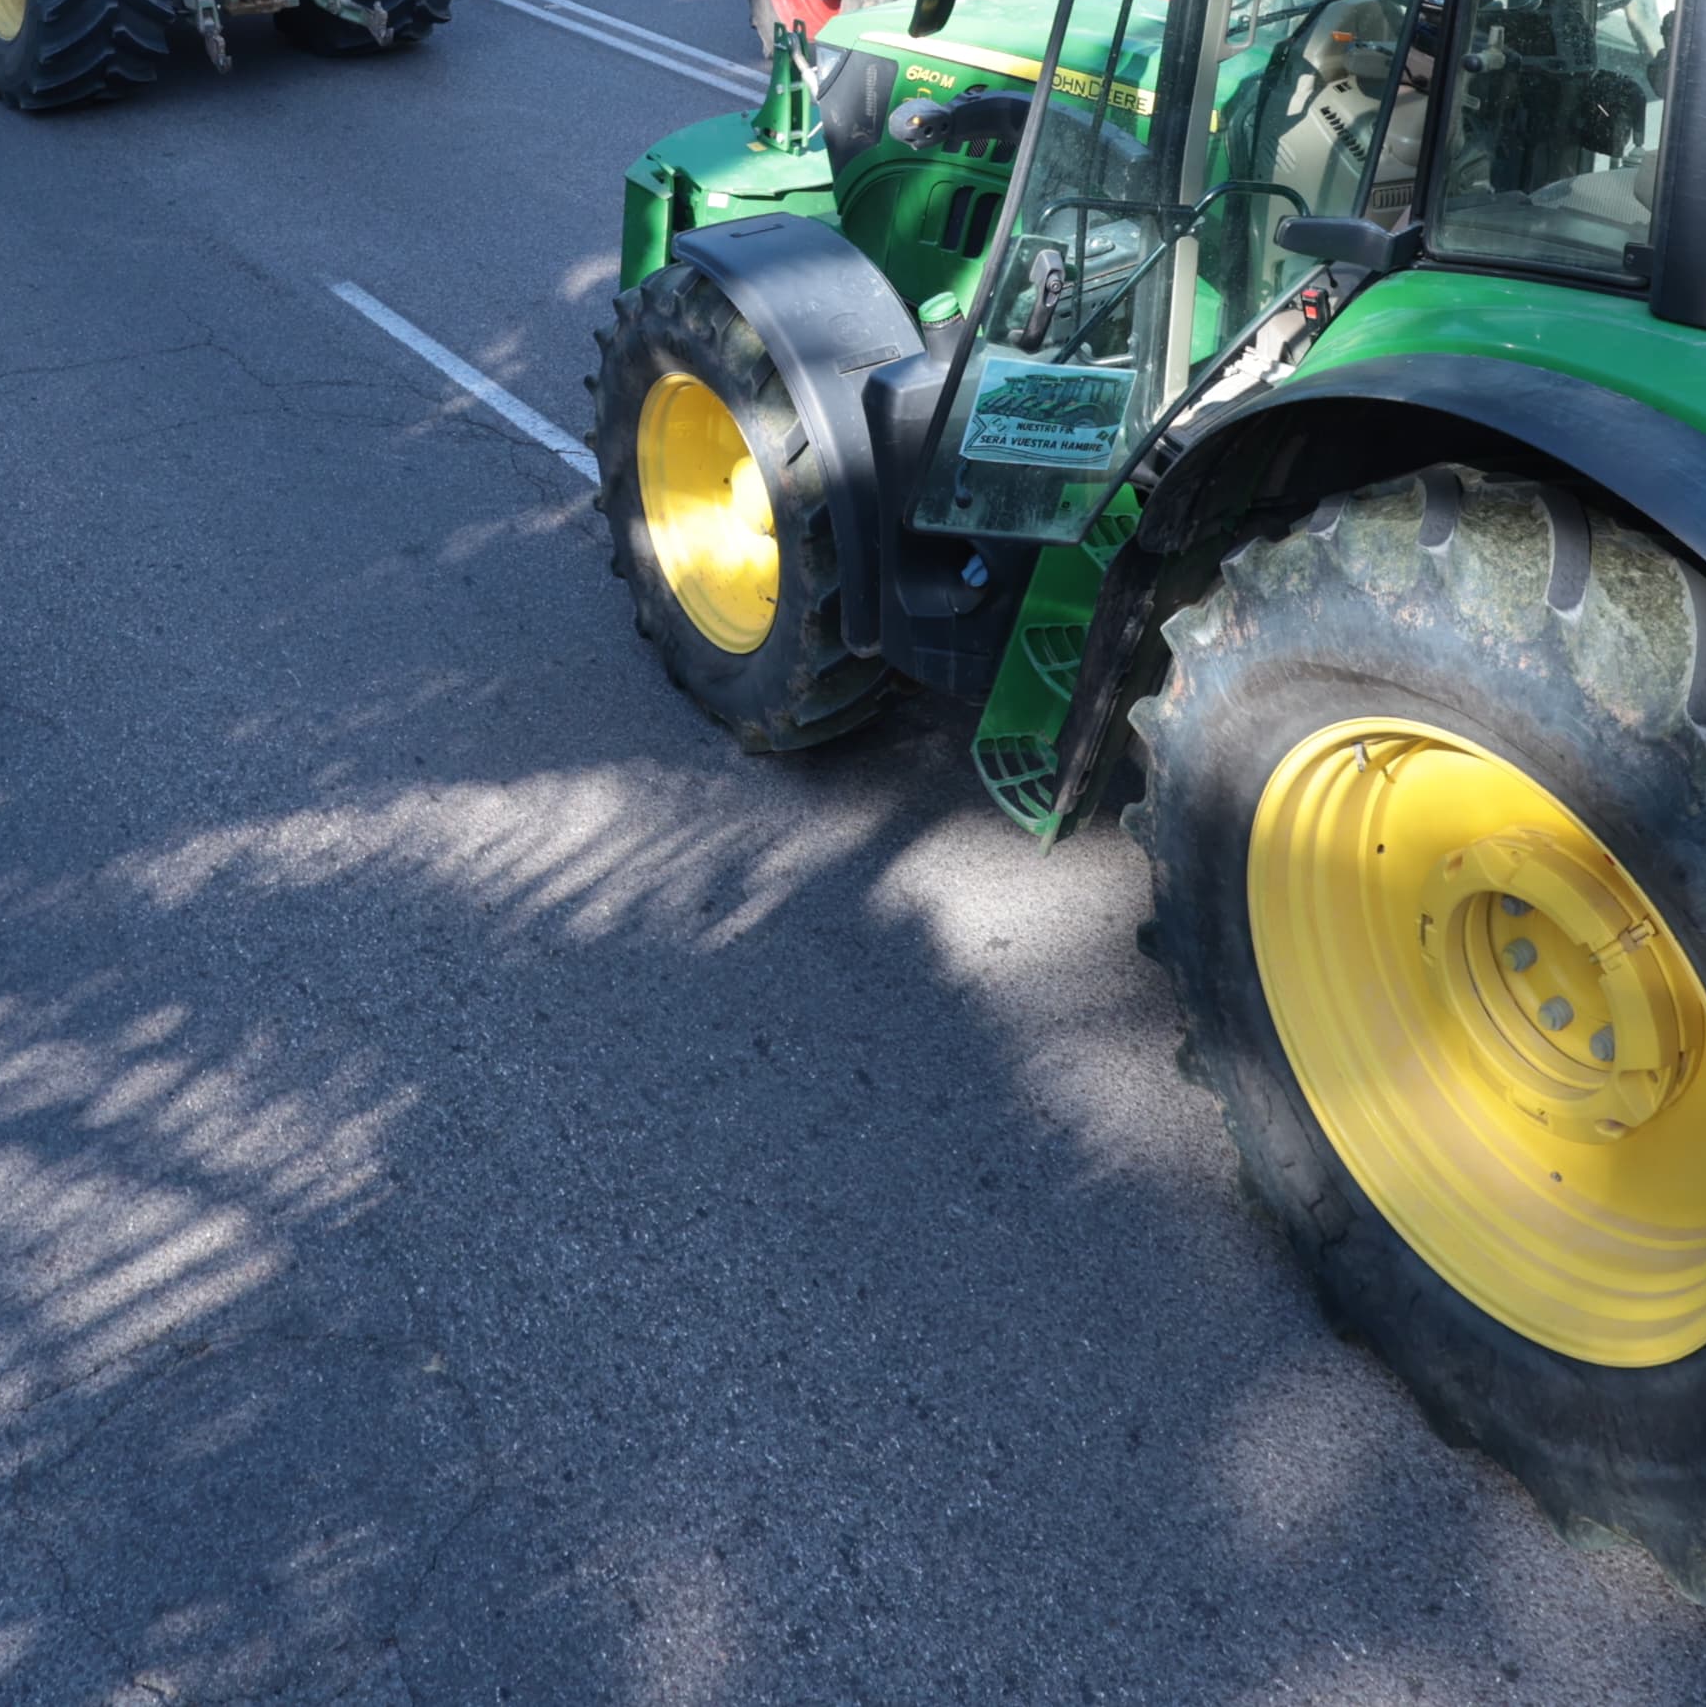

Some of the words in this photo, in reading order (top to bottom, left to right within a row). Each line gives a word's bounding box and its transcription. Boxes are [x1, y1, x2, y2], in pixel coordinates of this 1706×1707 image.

[1051, 74, 1086, 98] OHN
[1016, 422, 1057, 434] NUESTRO
[1011, 436, 1057, 449] VUESTRA
[1061, 441, 1103, 452] HAMBRE
